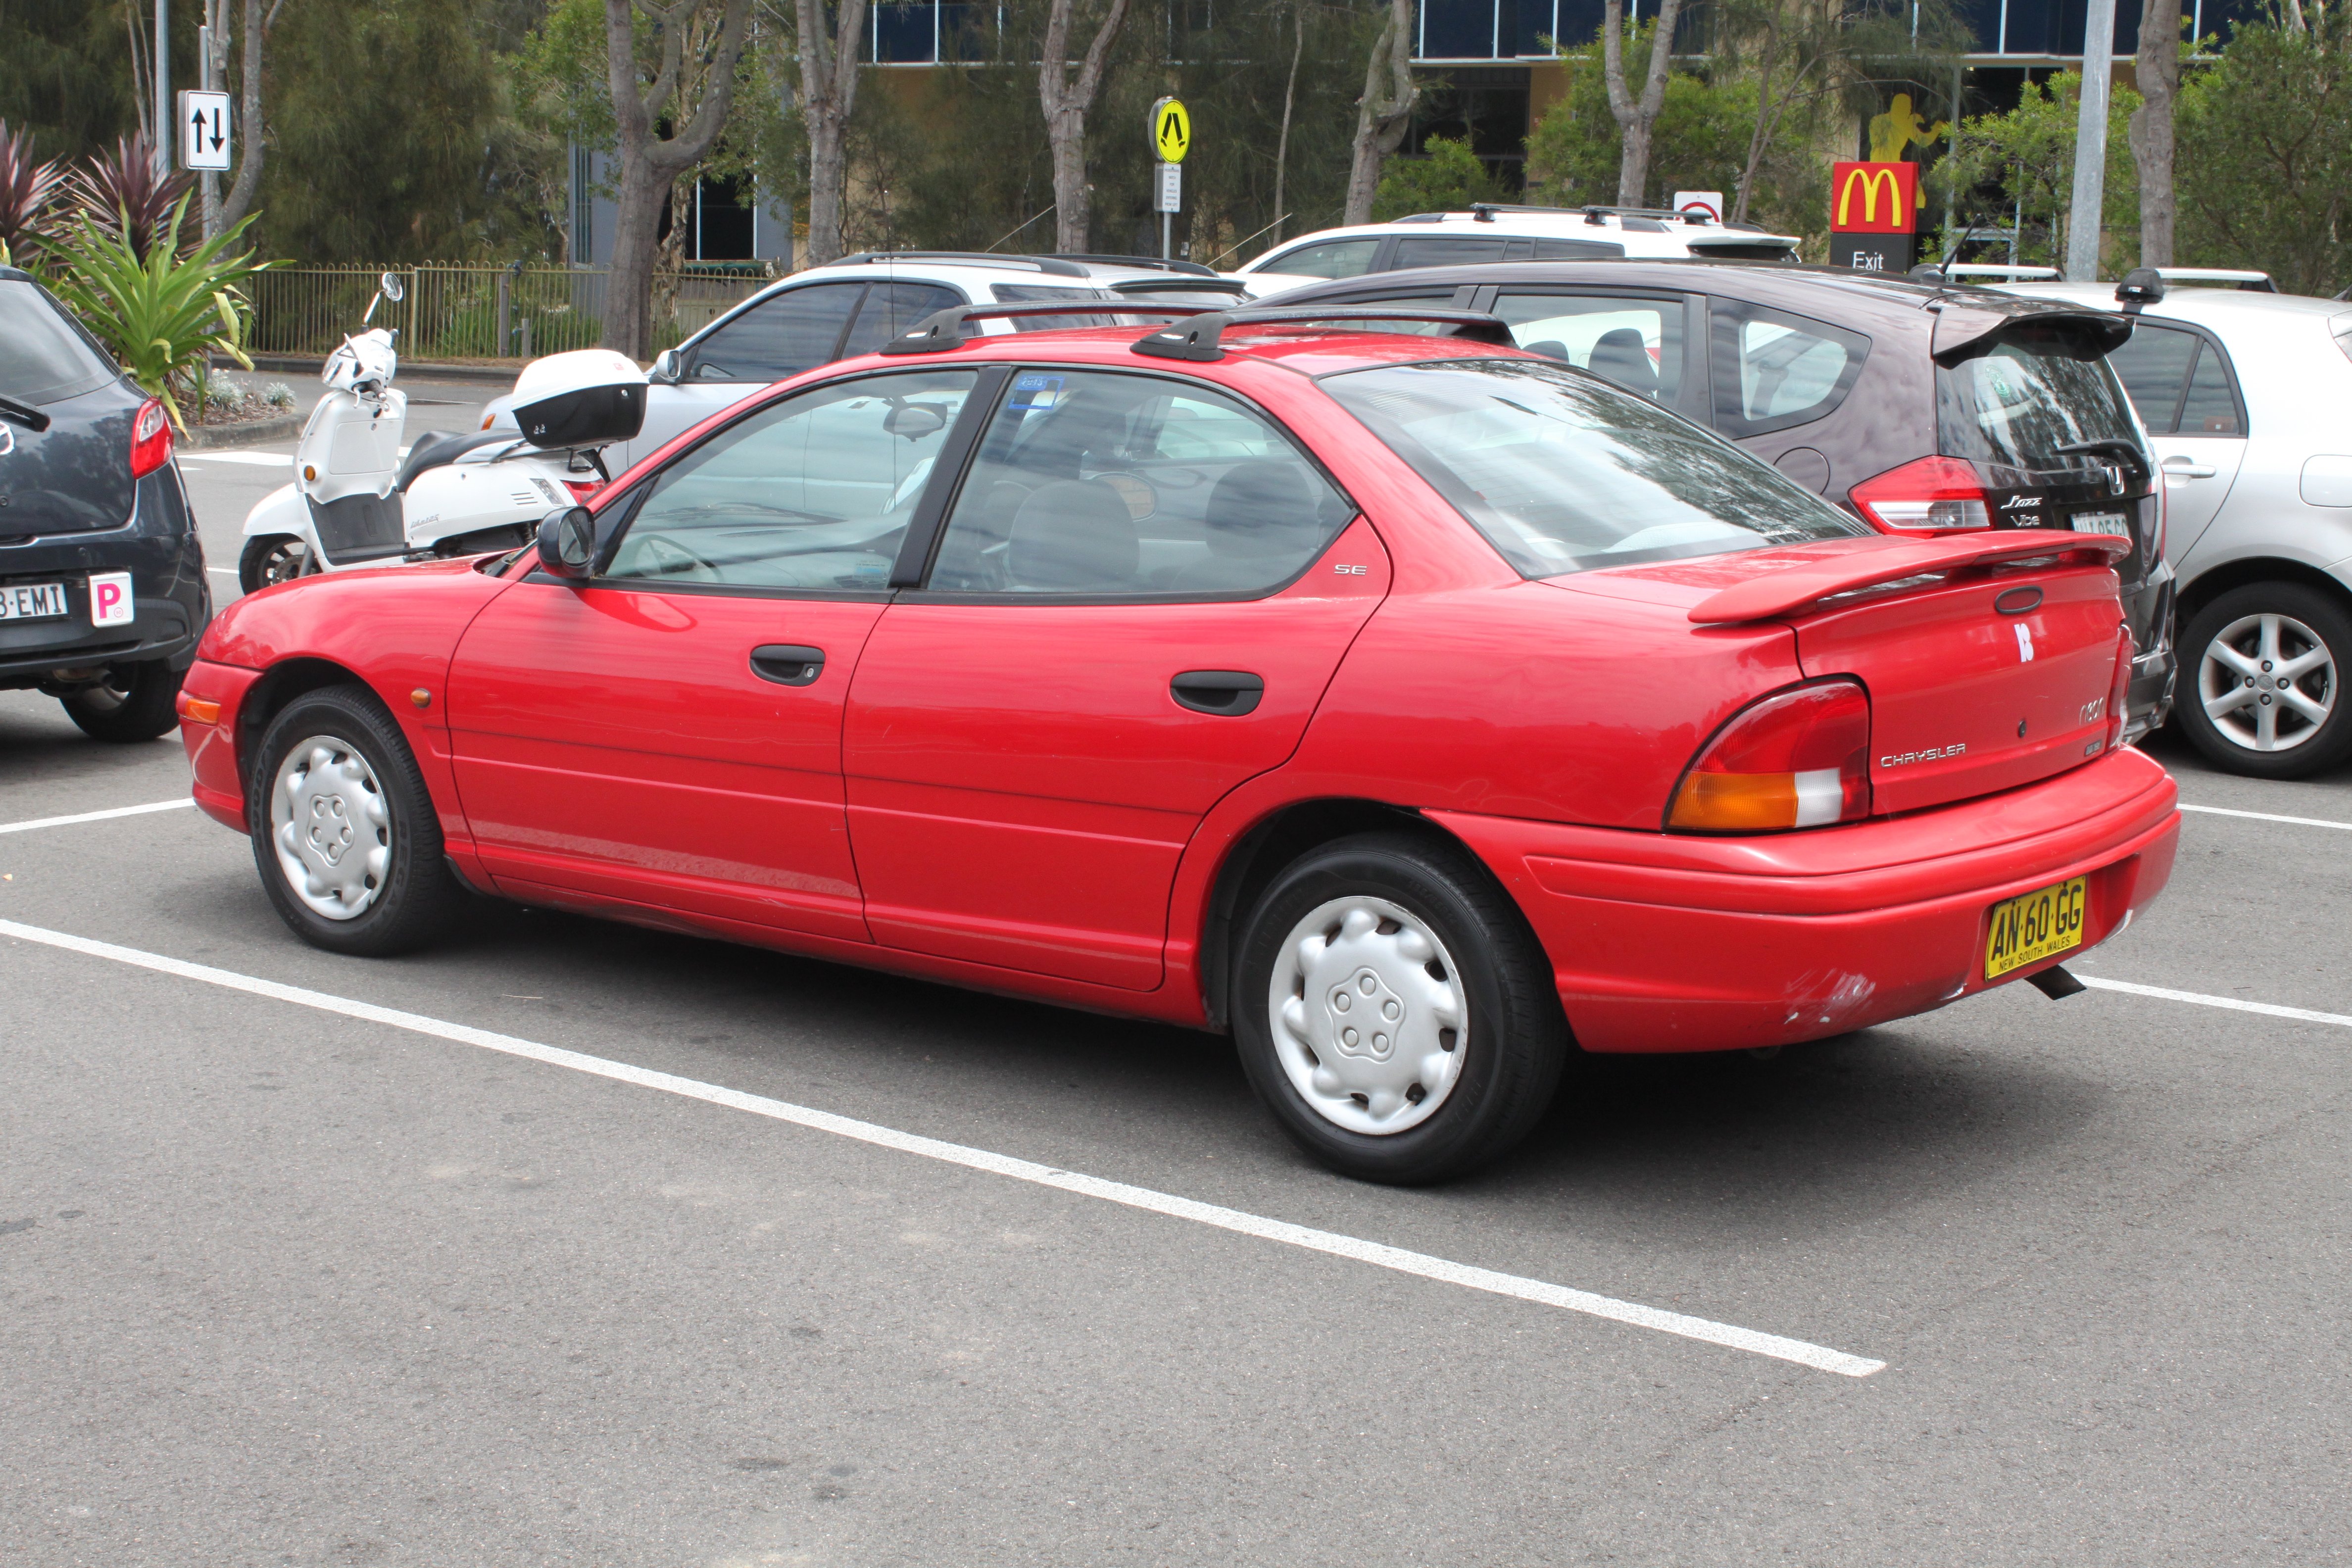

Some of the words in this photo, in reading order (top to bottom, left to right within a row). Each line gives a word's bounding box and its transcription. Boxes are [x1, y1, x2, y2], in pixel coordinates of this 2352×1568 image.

[1853, 251, 1884, 272] Exit
[1334, 564, 1368, 575] SE
[97, 583, 121, 619] P
[1880, 743, 1966, 768] CHRYSLER
[1999, 956, 2014, 972] NEW
[2018, 944, 2042, 964] SOUTH
[2047, 935, 2070, 953] WALES
